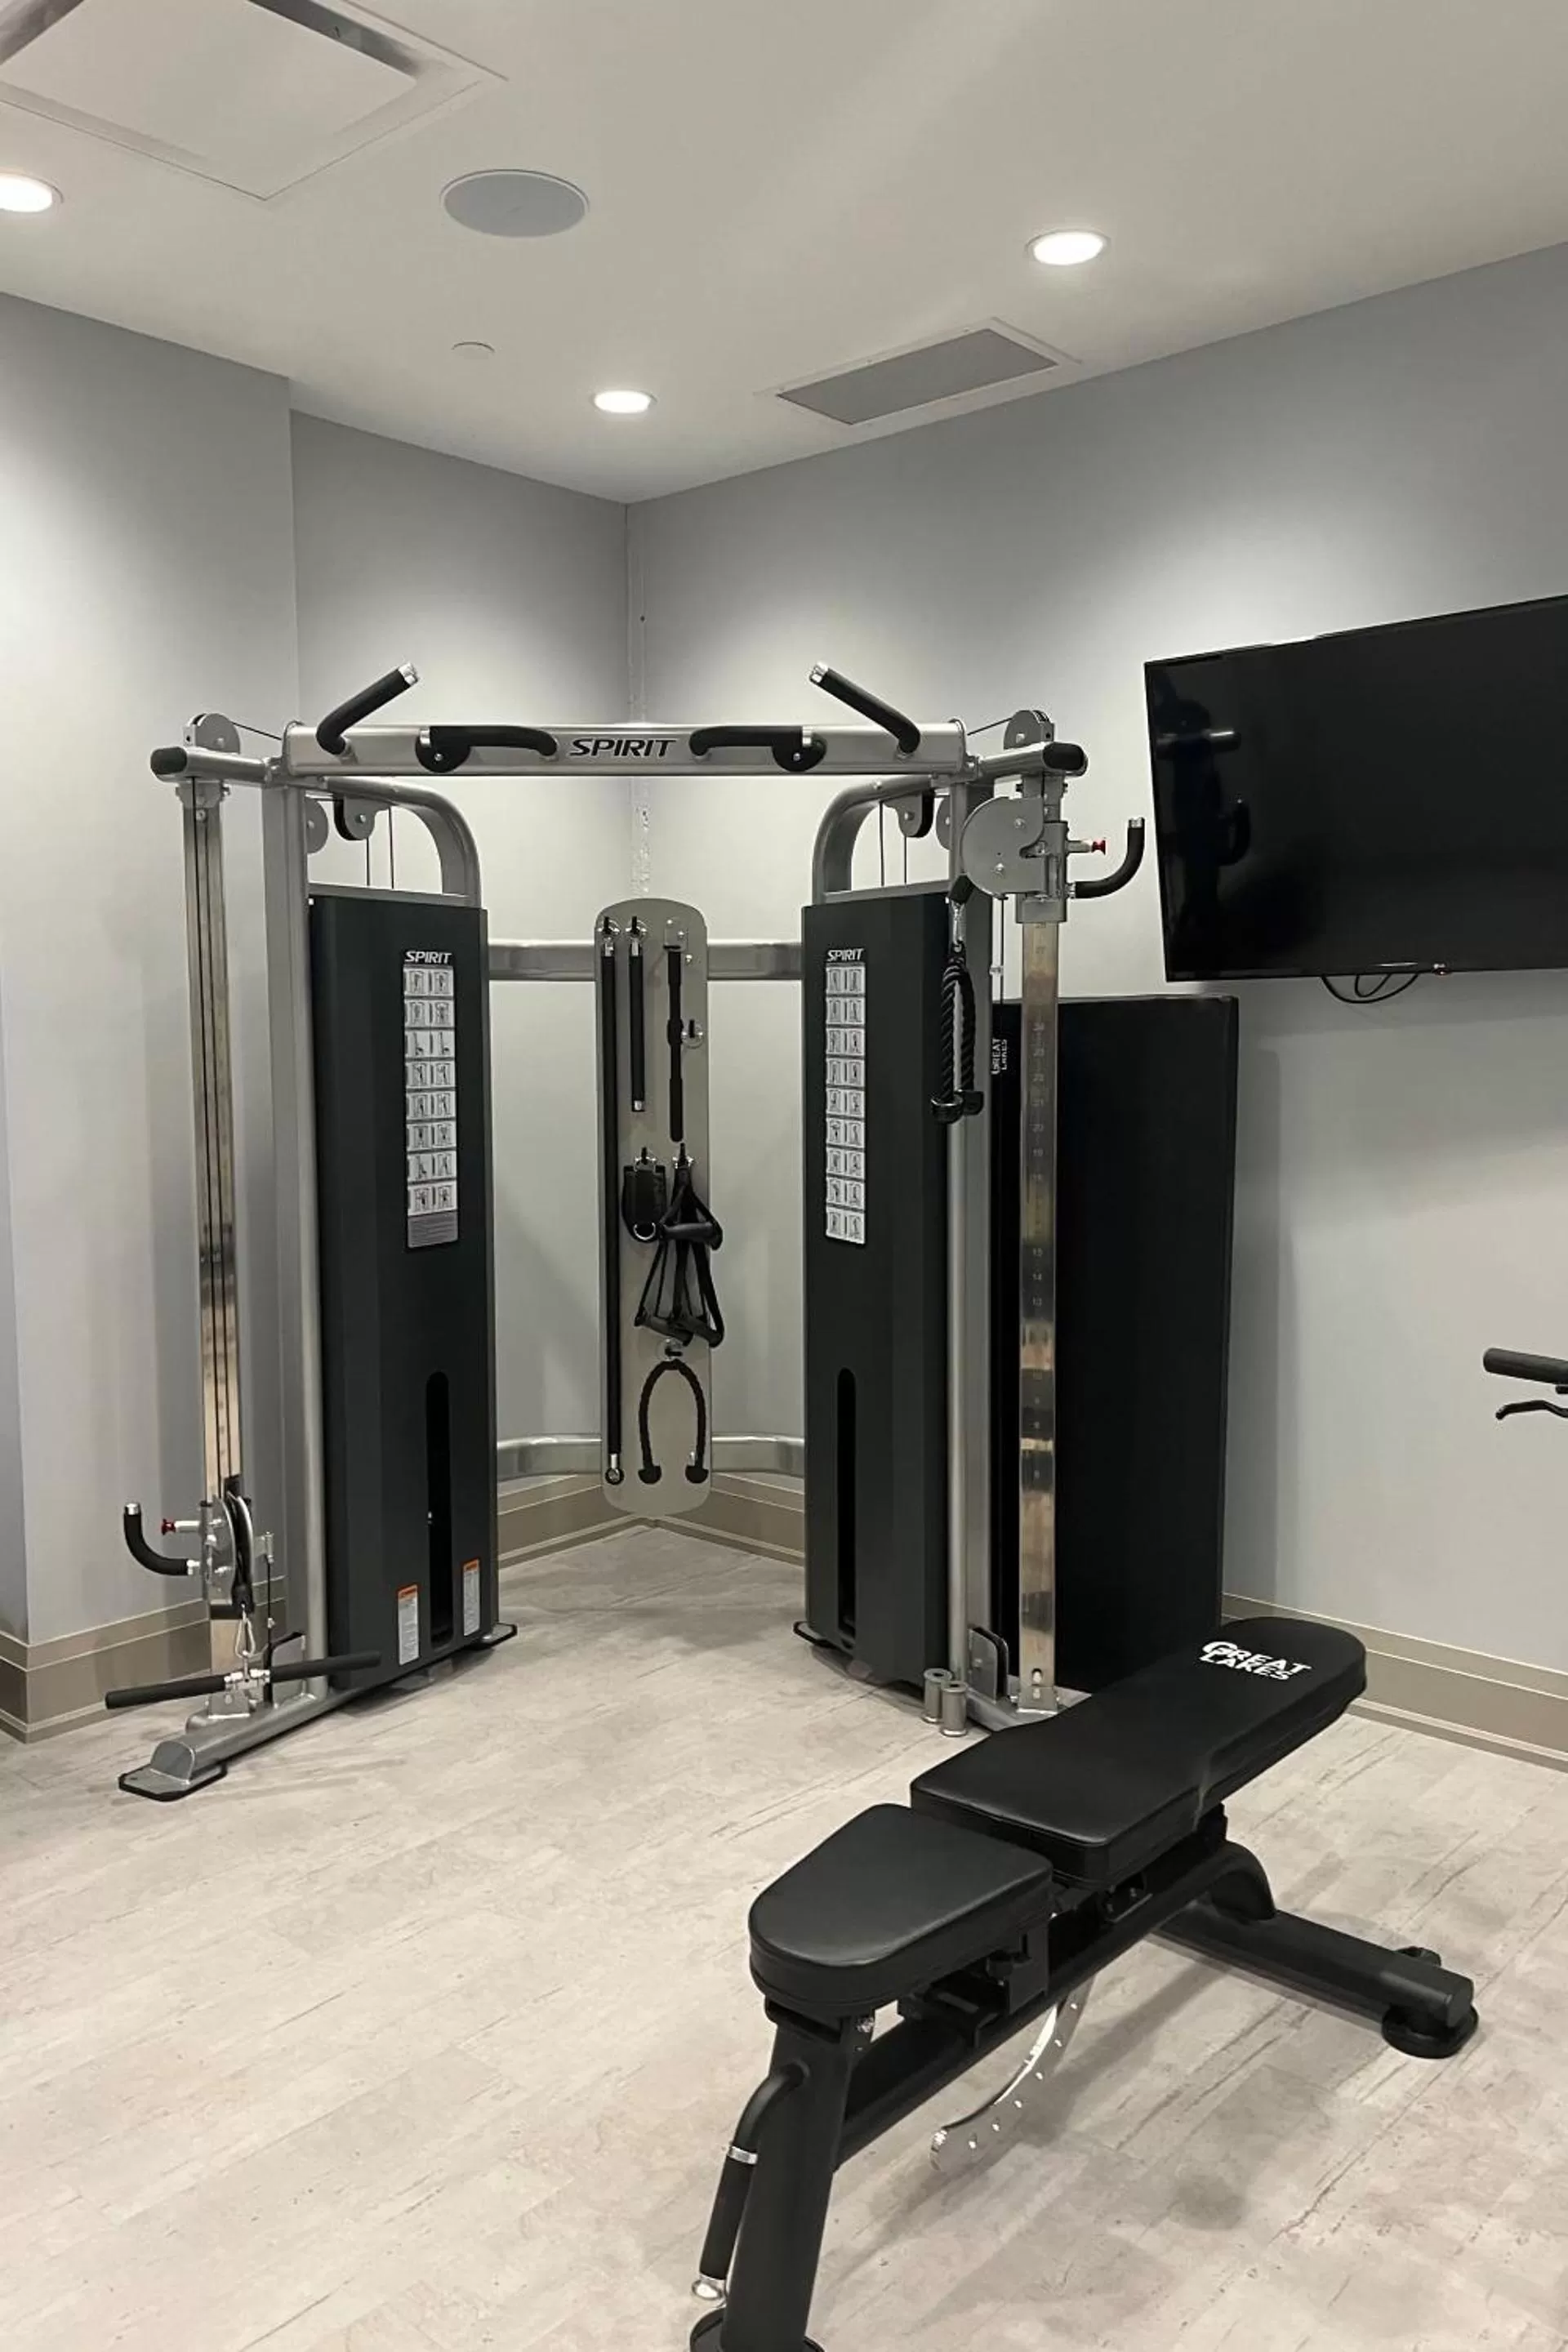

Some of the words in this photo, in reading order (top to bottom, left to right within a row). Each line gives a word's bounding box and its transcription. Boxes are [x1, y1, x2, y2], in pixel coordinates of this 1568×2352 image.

[570, 738, 677, 757] SPIRIT
[404, 950, 452, 964] SPIRIT
[826, 948, 865, 962] SPIRIT
[991, 1038, 1000, 1075] GREAT
[1200, 1650, 1290, 1681] LAKES
[1202, 1641, 1312, 1675] GREAT
